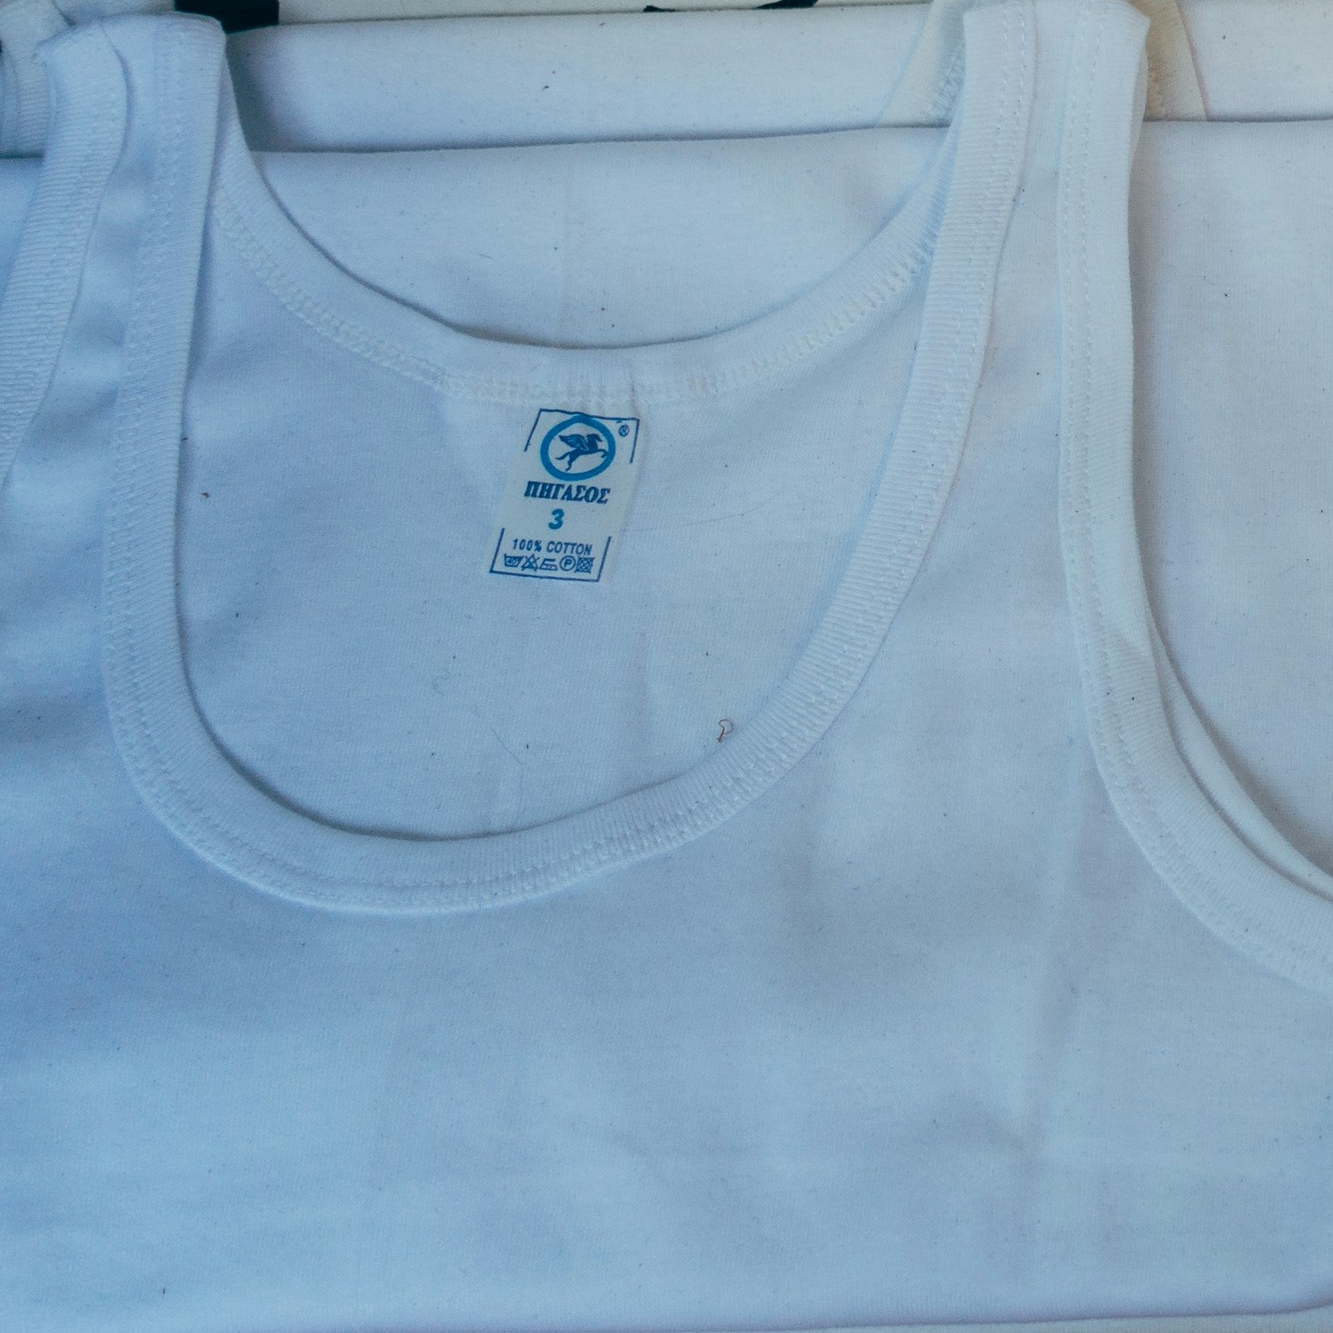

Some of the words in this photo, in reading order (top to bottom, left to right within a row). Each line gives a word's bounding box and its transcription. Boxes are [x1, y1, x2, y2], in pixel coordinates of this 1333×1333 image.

[523, 480, 611, 505] ΠΗΓΑΣΟΣ
[548, 507, 565, 530] 3
[512, 537, 543, 553] 100%
[546, 540, 593, 556] COTTON
